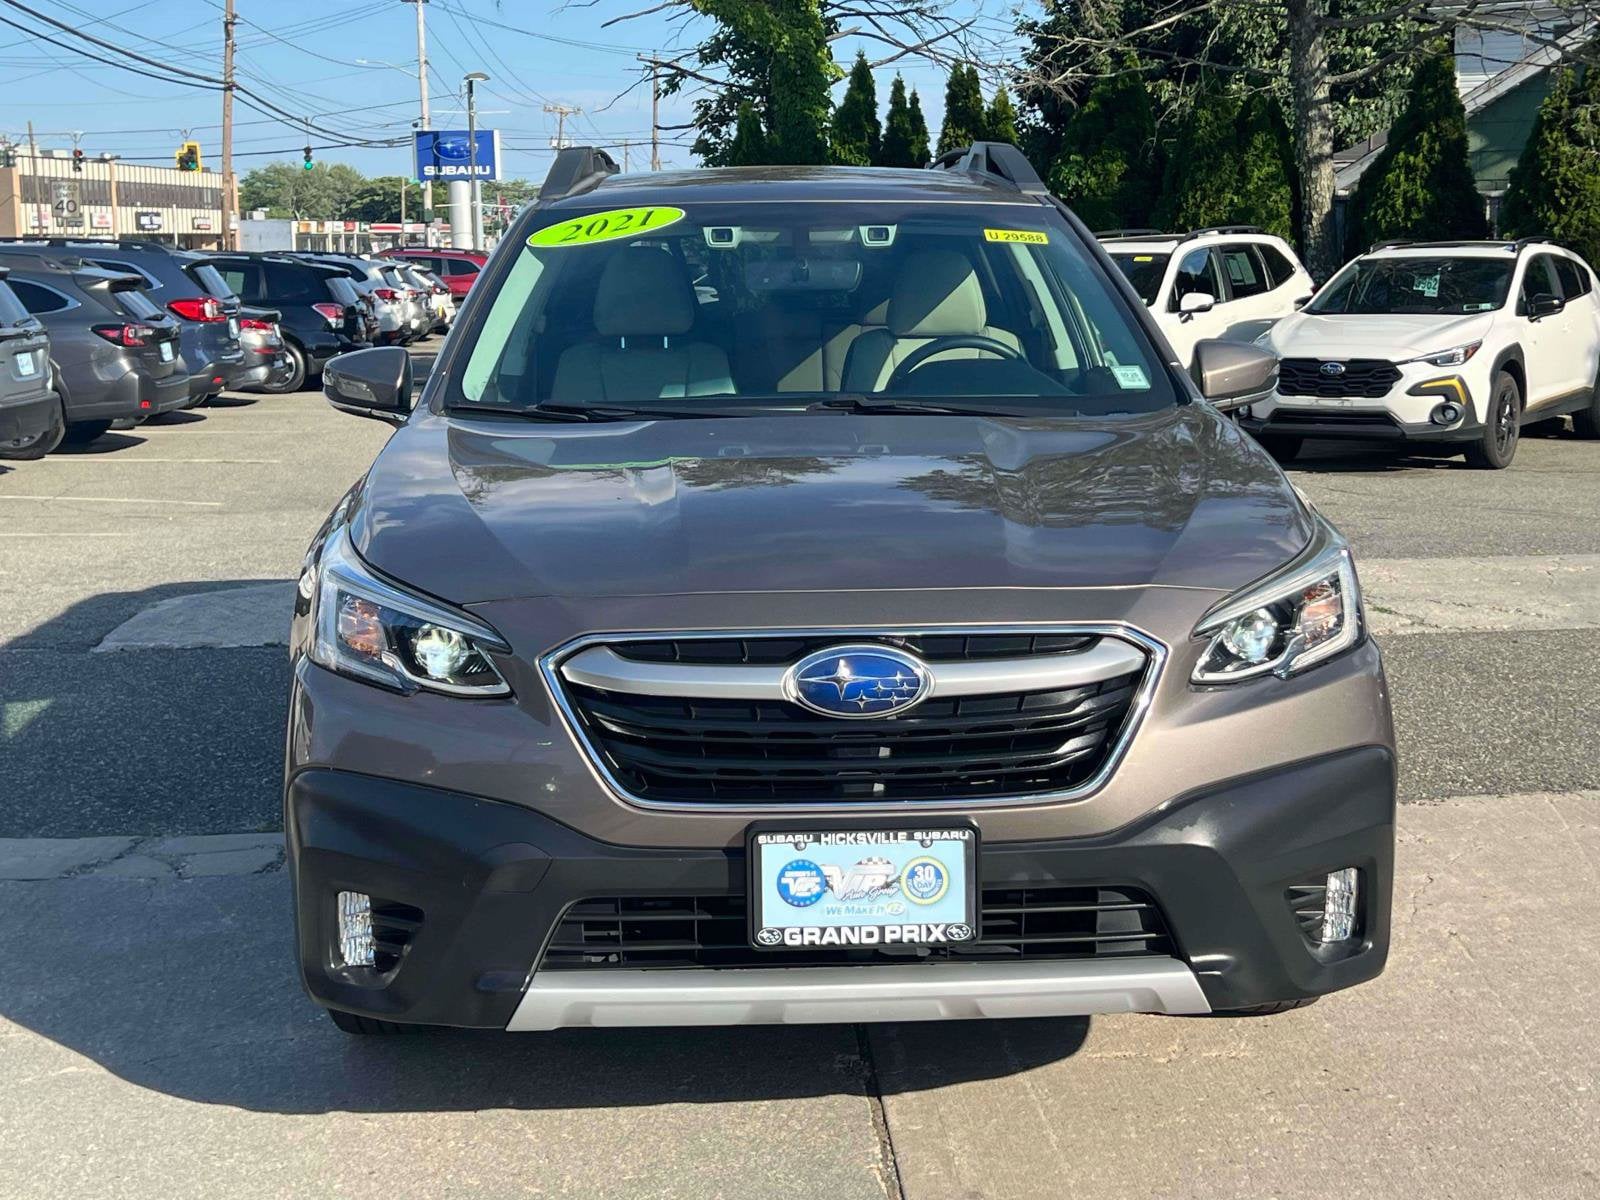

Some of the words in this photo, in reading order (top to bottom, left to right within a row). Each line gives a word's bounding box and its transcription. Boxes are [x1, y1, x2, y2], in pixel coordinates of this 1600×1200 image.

[423, 165, 490, 176] SUBARU
[55, 200, 77, 213] 40
[559, 209, 655, 243] 2021
[988, 231, 999, 241] U
[1003, 232, 1044, 242] 29588
[758, 834, 814, 844] SUBARU
[820, 831, 908, 846] HICKSVILLE
[913, 830, 969, 840] SUBARU
[914, 865, 935, 881] 30
[917, 880, 932, 889] DAY
[784, 926, 880, 945] GRAND
[884, 923, 948, 944] PRIX
